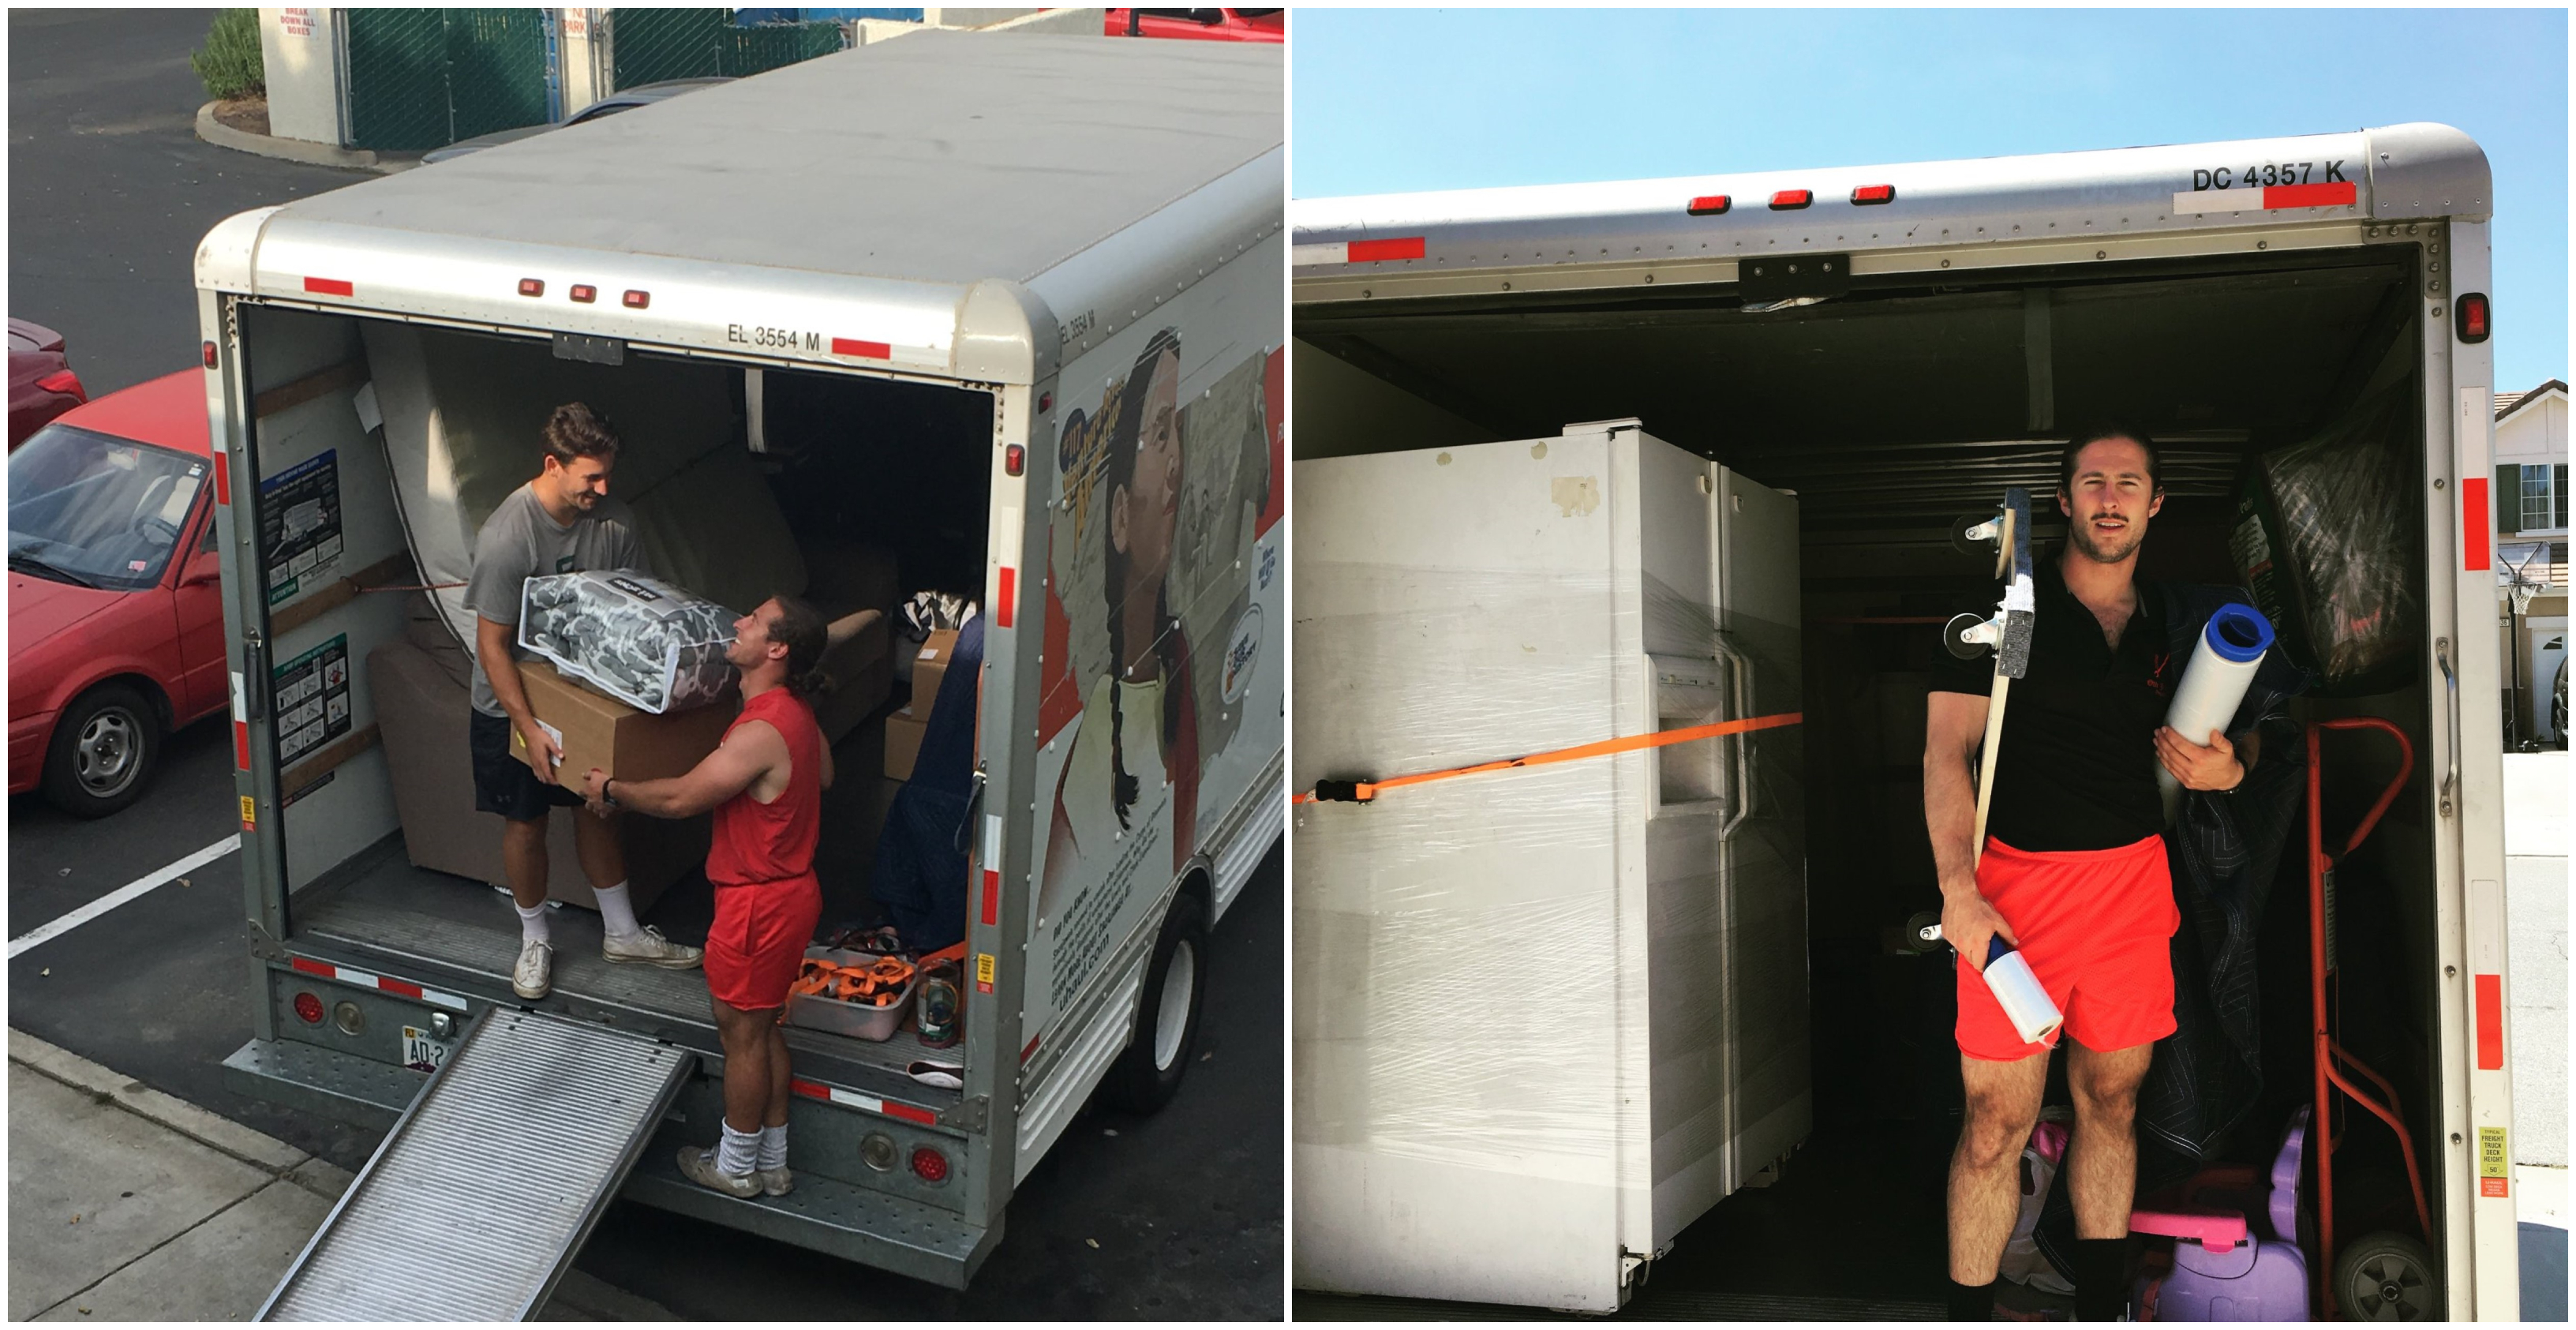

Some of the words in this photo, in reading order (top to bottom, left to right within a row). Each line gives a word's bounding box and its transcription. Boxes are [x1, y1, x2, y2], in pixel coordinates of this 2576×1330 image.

[280, 16, 301, 25] DOWN
[303, 18, 316, 27] ALL
[287, 26, 311, 36] BOXES
[2192, 167, 2232, 191] DC
[2244, 162, 2312, 188] 4357
[2325, 160, 2346, 182] K
[728, 324, 748, 343] EL
[755, 326, 798, 348] 3554
[806, 332, 820, 351] M
[1060, 933, 1110, 1012] uhaul.com
